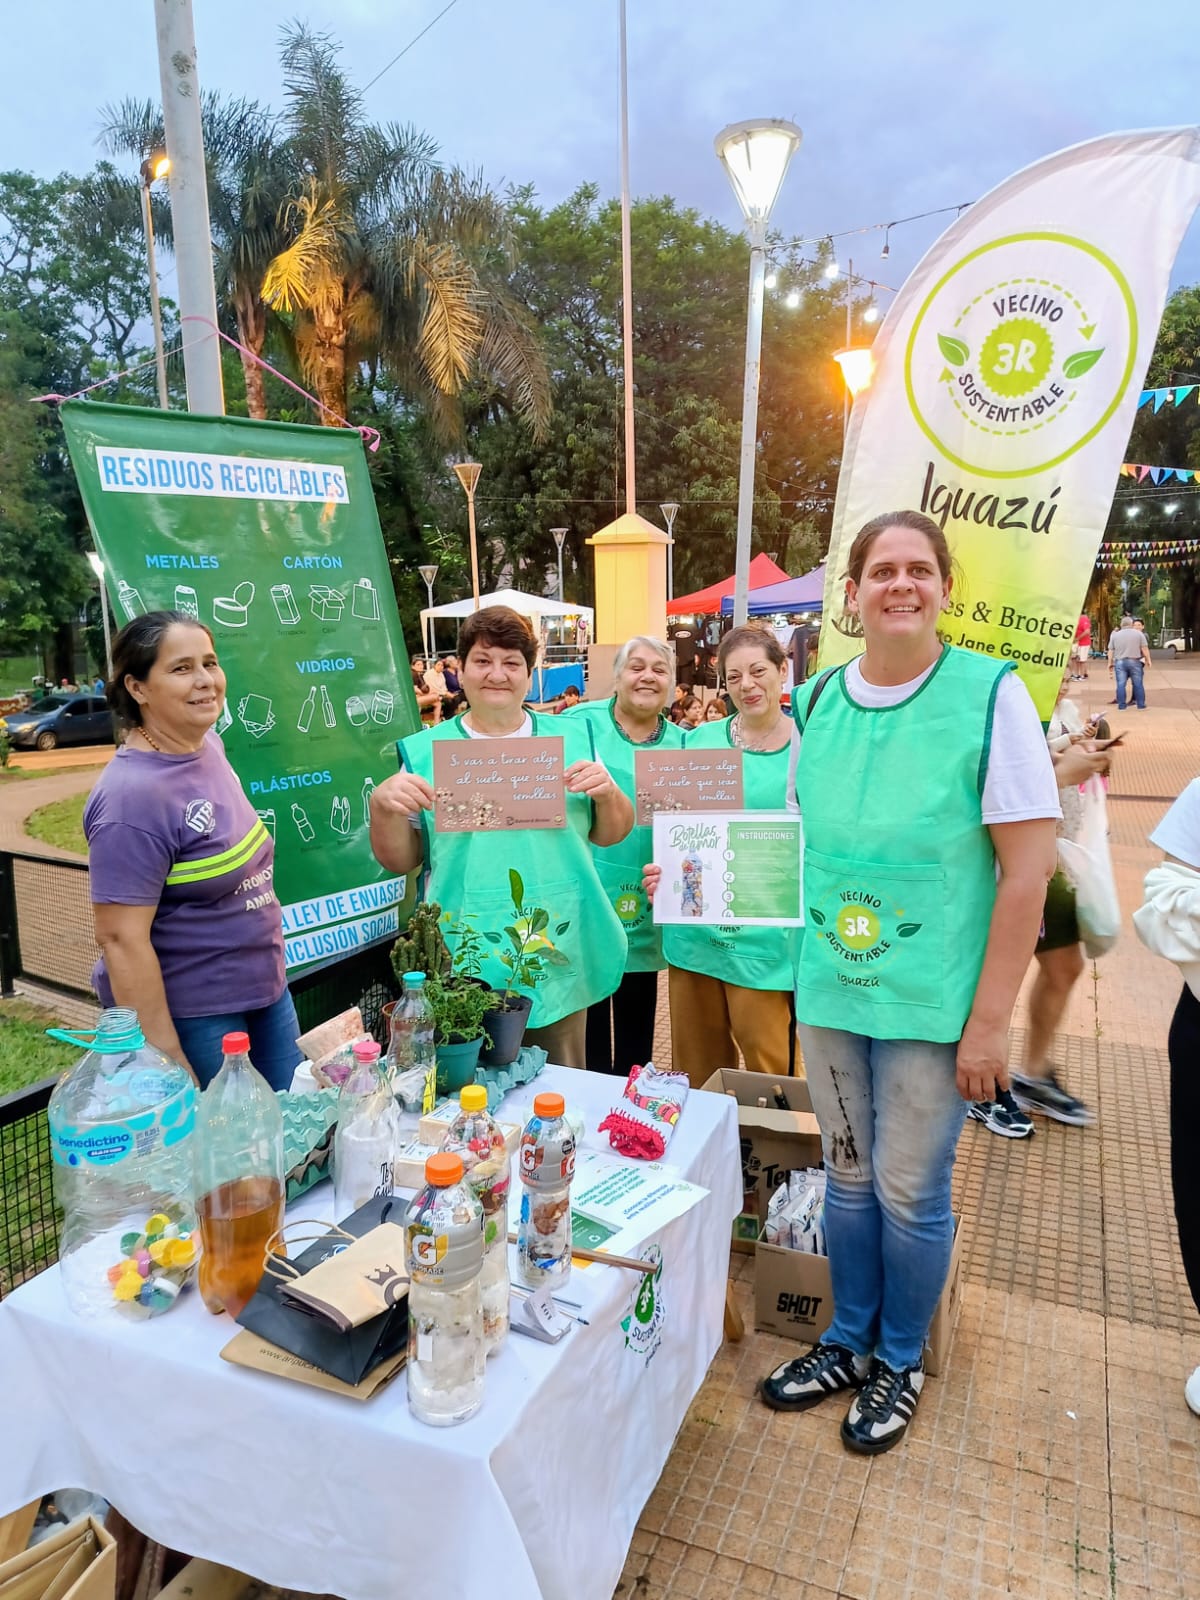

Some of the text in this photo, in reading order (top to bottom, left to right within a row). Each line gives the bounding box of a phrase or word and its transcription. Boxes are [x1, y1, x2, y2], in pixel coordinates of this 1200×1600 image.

[993, 294, 1064, 323] VECINO
[992, 338, 1037, 376] 3R
[959, 373, 1065, 422] SUSTENTABLE
[103, 455, 345, 498] RESIDUOS RECICLABLES
[920, 461, 1062, 535] Iguazú
[145, 553, 220, 569] METALES
[283, 553, 343, 569] CARTÓN
[972, 601, 993, 624] &
[998, 606, 1075, 640] Brotes
[956, 633, 996, 654] Jane
[1000, 642, 1065, 668] Goodall
[296, 657, 355, 674] VIDRIOS
[463, 758, 484, 766] vas
[532, 751, 559, 770] algo
[715, 759, 738, 776] algo
[250, 770, 332, 795] PLÁSTICOS
[456, 771, 559, 789] al suelo que sean
[653, 776, 665, 787] al
[668, 775, 692, 787] suelo
[696, 780, 713, 791] que
[512, 786, 557, 801] semillas
[698, 790, 736, 801] semillas
[186, 801, 213, 833] UTEP
[669, 823, 717, 848] Botellas
[690, 836, 721, 851] amor
[737, 831, 795, 841] INSTRUCCIONES
[292, 902, 321, 928] LEY
[325, 896, 348, 919] DE
[349, 879, 405, 913] ENVASES
[620, 900, 637, 912] 3R
[840, 890, 882, 908] VECINO
[361, 912, 397, 942] SOCIAL
[845, 916, 871, 937] 3R
[825, 931, 891, 962] SUSTENTABLE
[836, 971, 880, 987] Iguazú
[58, 1133, 130, 1149] benedictino
[521, 1143, 536, 1171] G
[412, 1234, 438, 1266] G
[776, 1292, 823, 1317] SHOT
